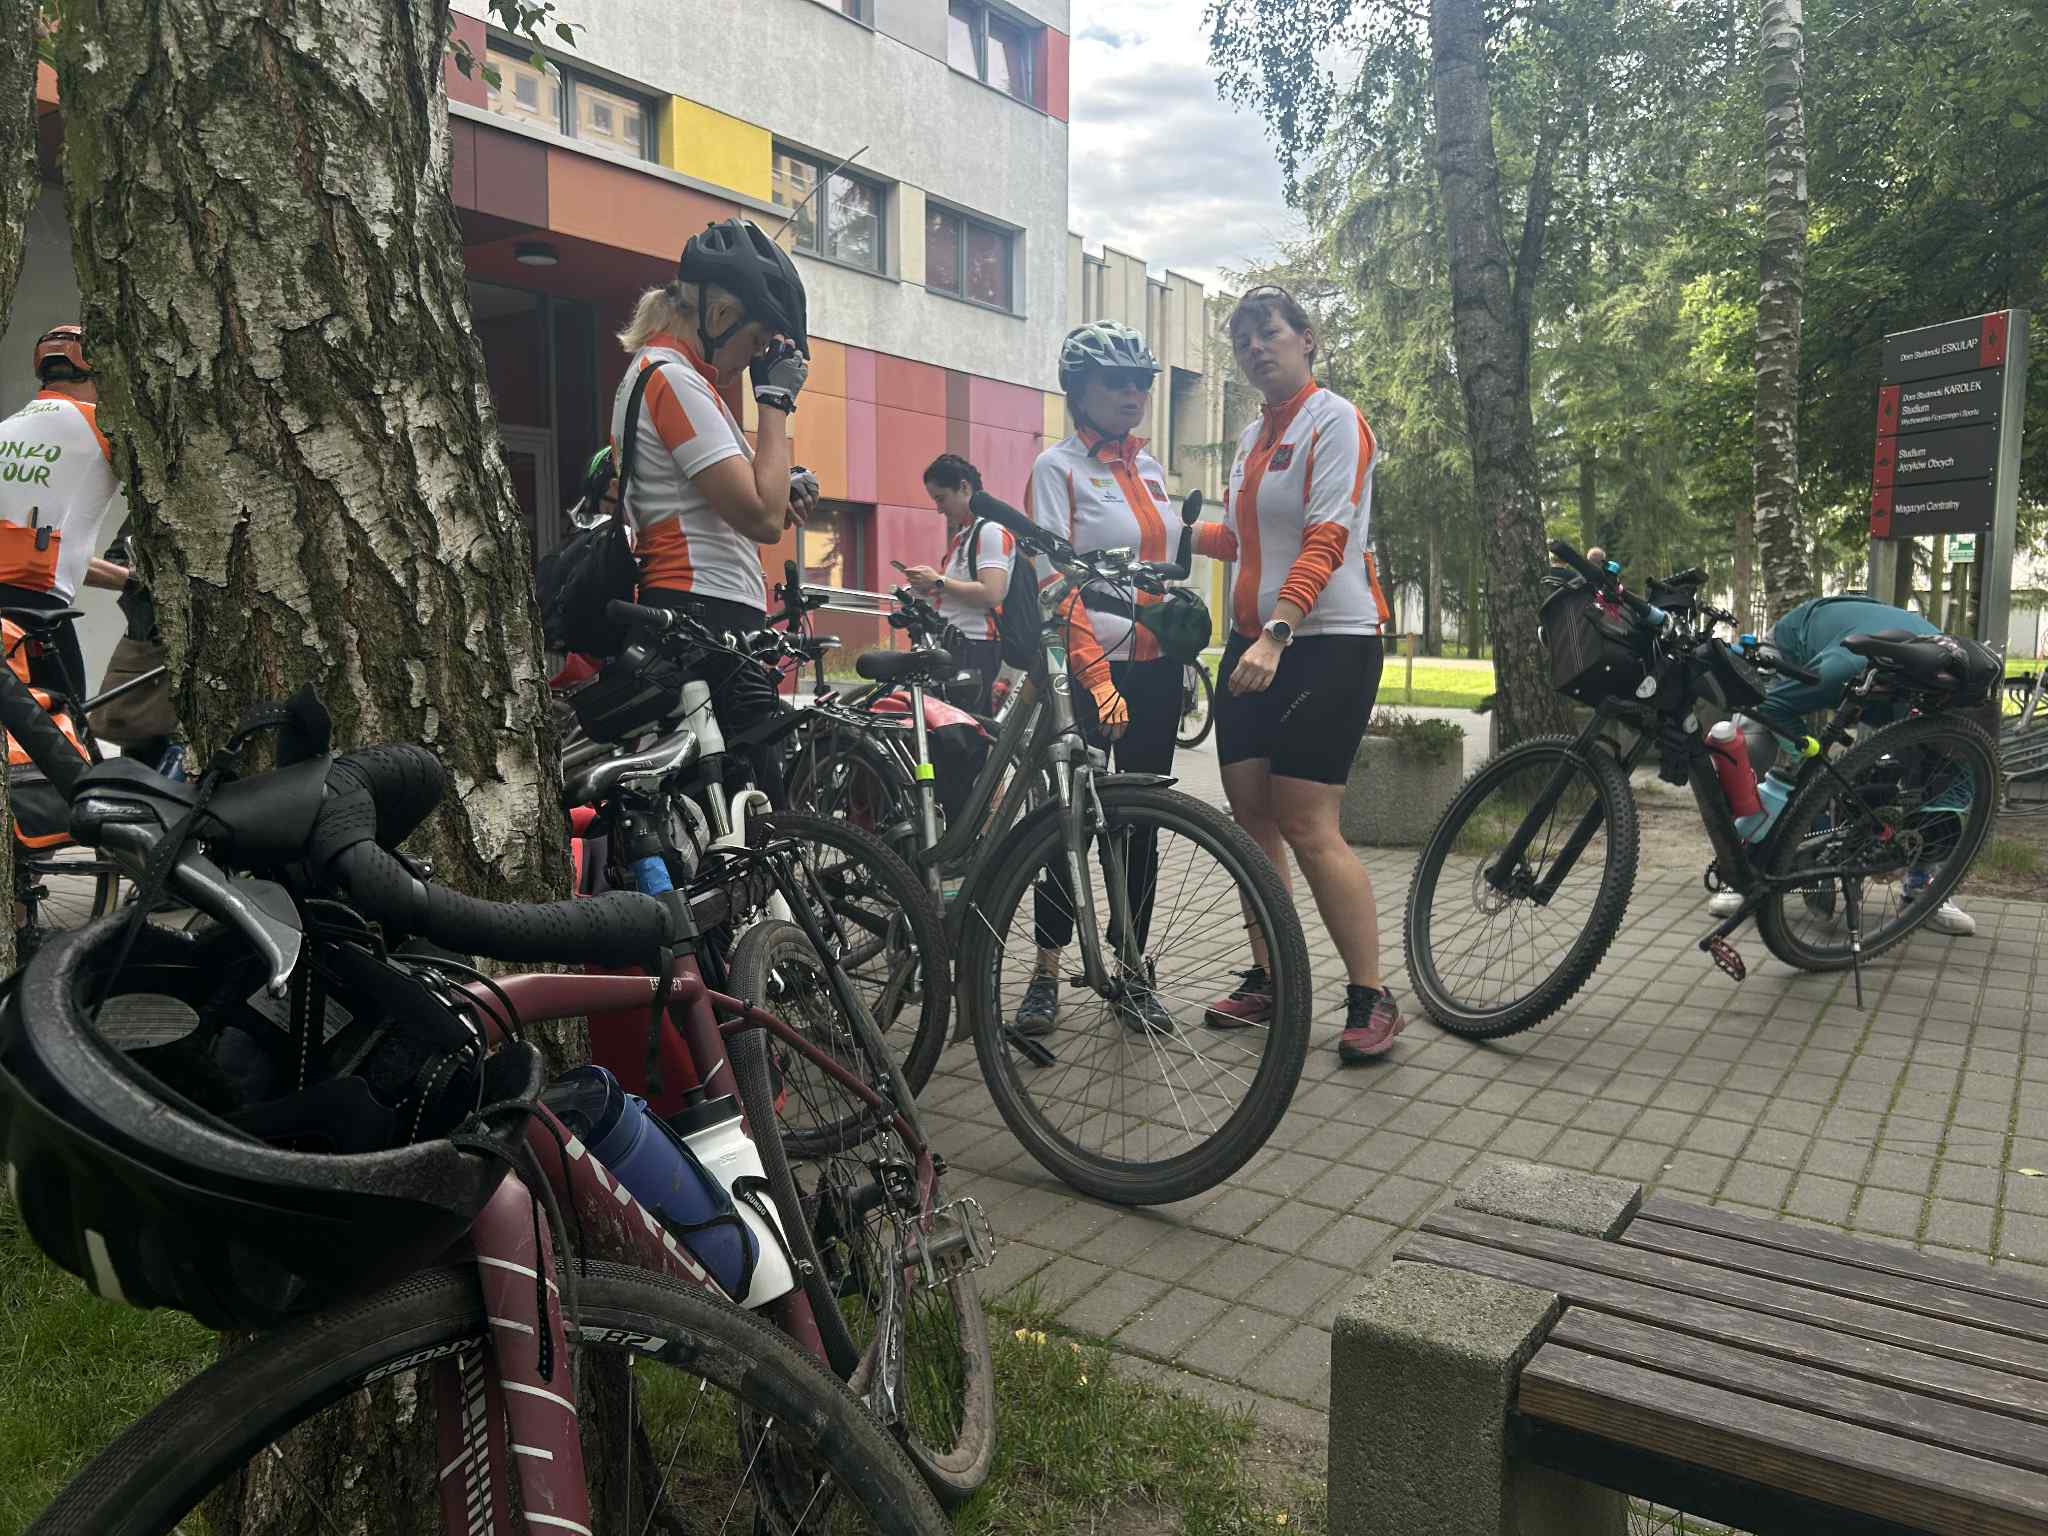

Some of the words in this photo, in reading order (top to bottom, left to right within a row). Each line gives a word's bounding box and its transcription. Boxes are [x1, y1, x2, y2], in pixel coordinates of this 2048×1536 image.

[1942, 338, 1979, 354] ESKULAP
[1944, 381, 1982, 396] KAROLEK
[0, 461, 51, 488] OUR
